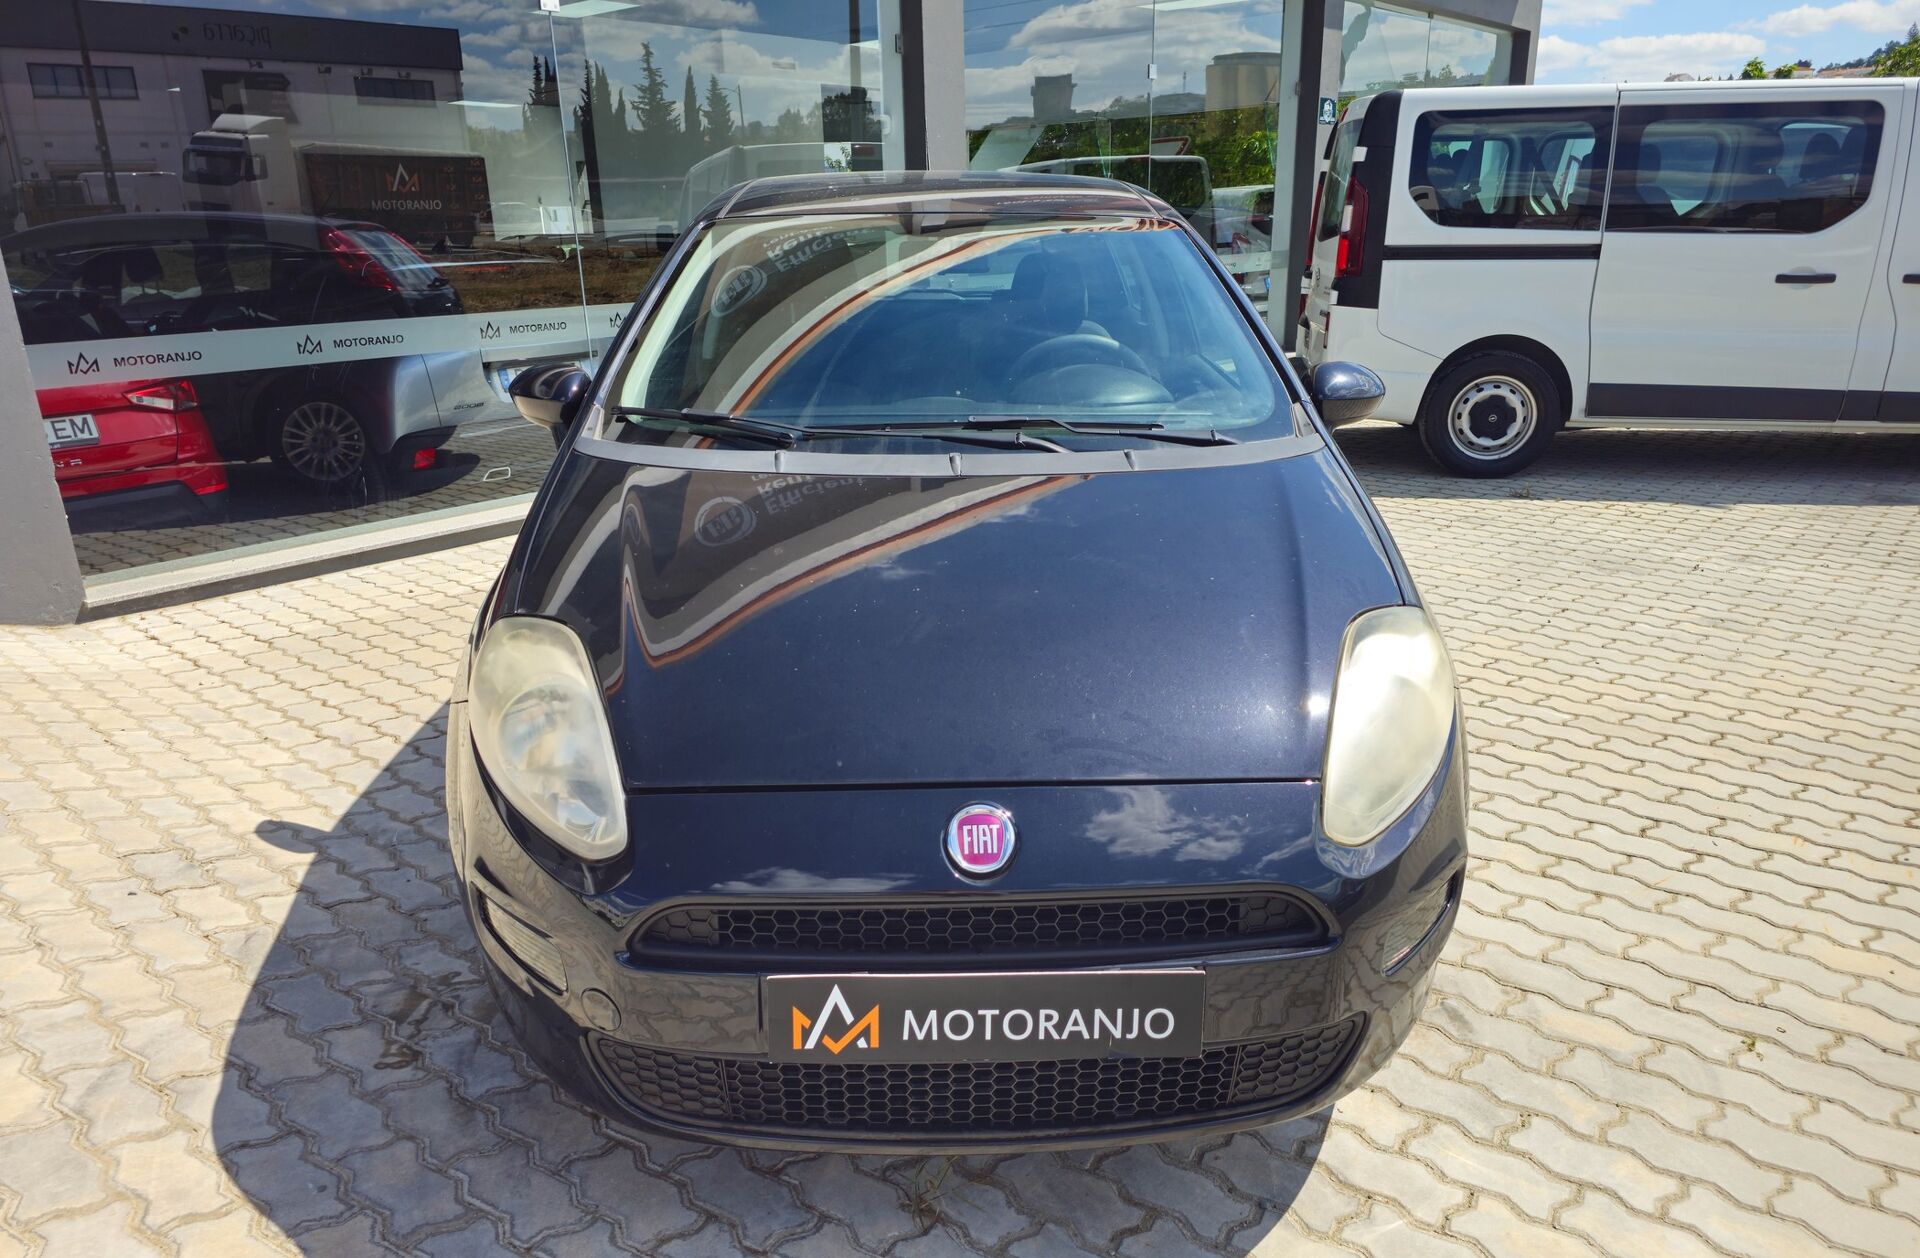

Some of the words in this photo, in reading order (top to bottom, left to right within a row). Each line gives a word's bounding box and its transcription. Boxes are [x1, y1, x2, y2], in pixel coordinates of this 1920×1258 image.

[371, 200, 442, 211] MOTORANJO
[508, 321, 567, 334] MOTORANJO
[332, 334, 405, 349] MOTORANJO
[112, 350, 203, 368] MOTORANJO
[962, 823, 1000, 855] FIAT
[902, 1008, 1175, 1041] MOTORANJO
